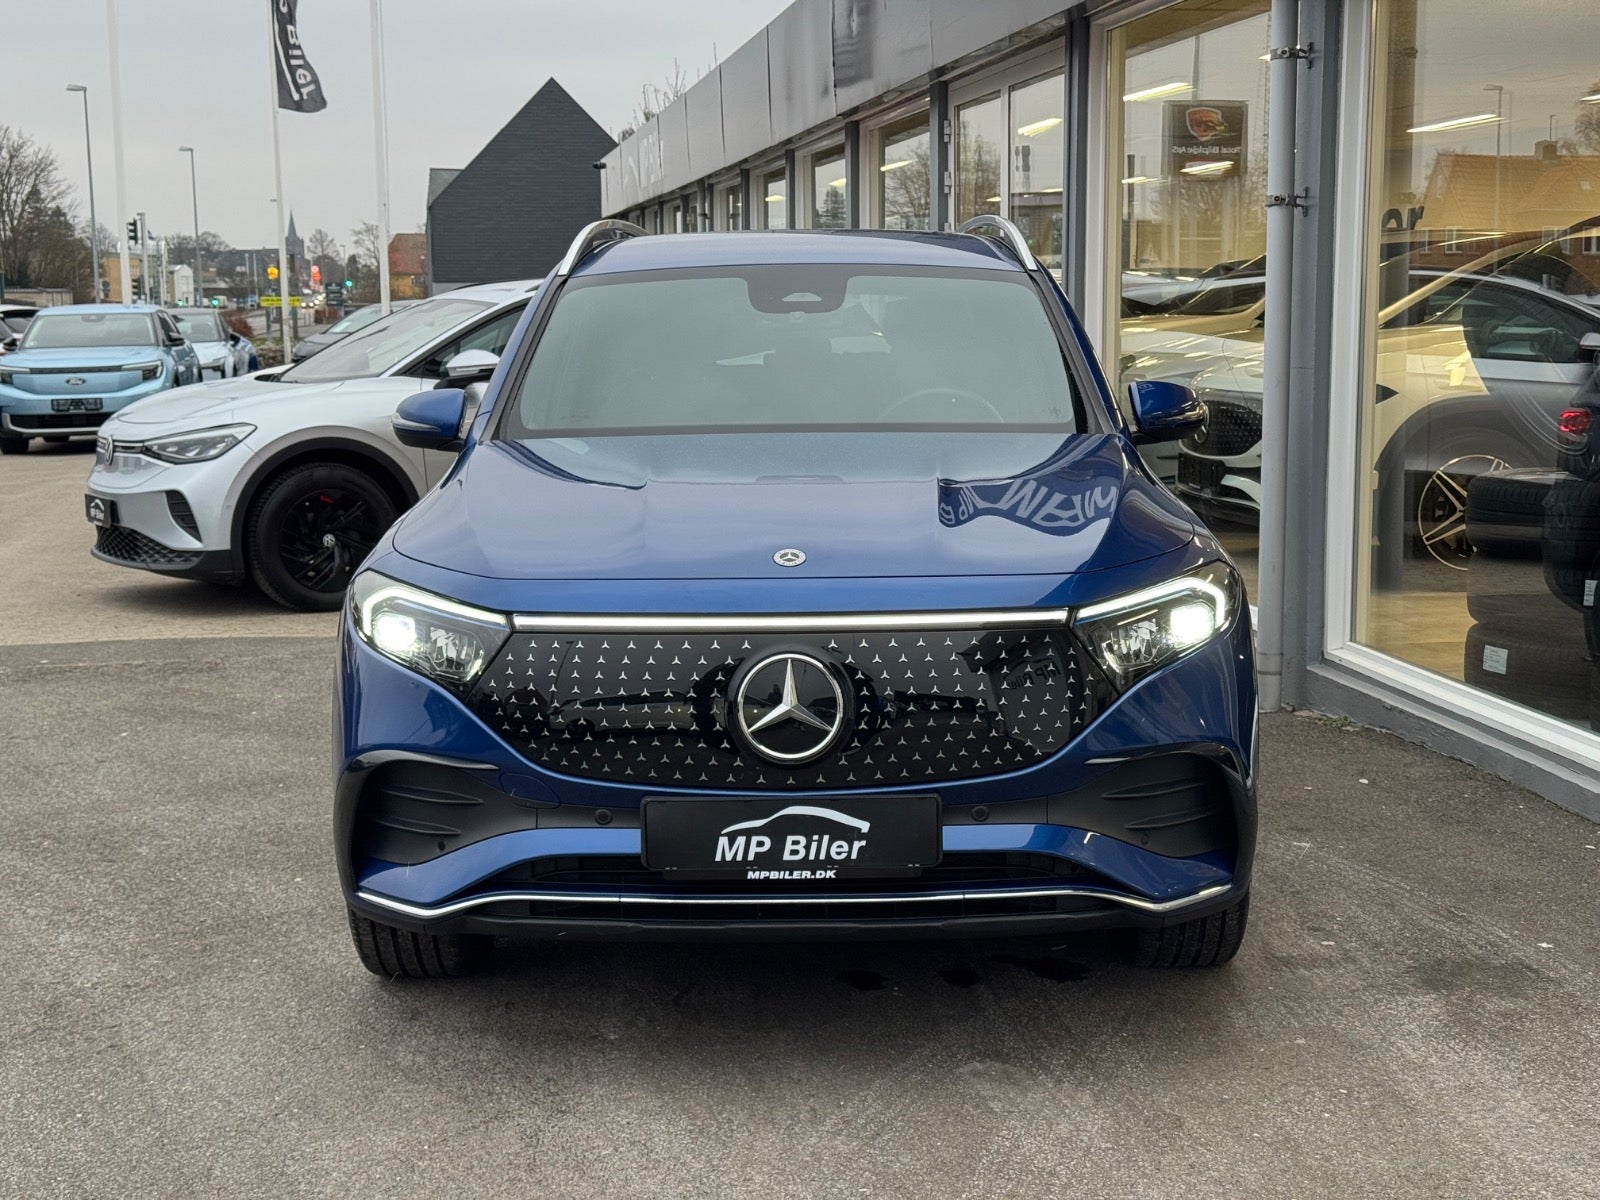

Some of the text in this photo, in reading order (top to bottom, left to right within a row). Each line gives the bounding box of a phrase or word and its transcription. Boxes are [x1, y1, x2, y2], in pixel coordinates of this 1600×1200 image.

[714, 834, 867, 862] MP Biler
[746, 869, 837, 880] MPBILER.DK
